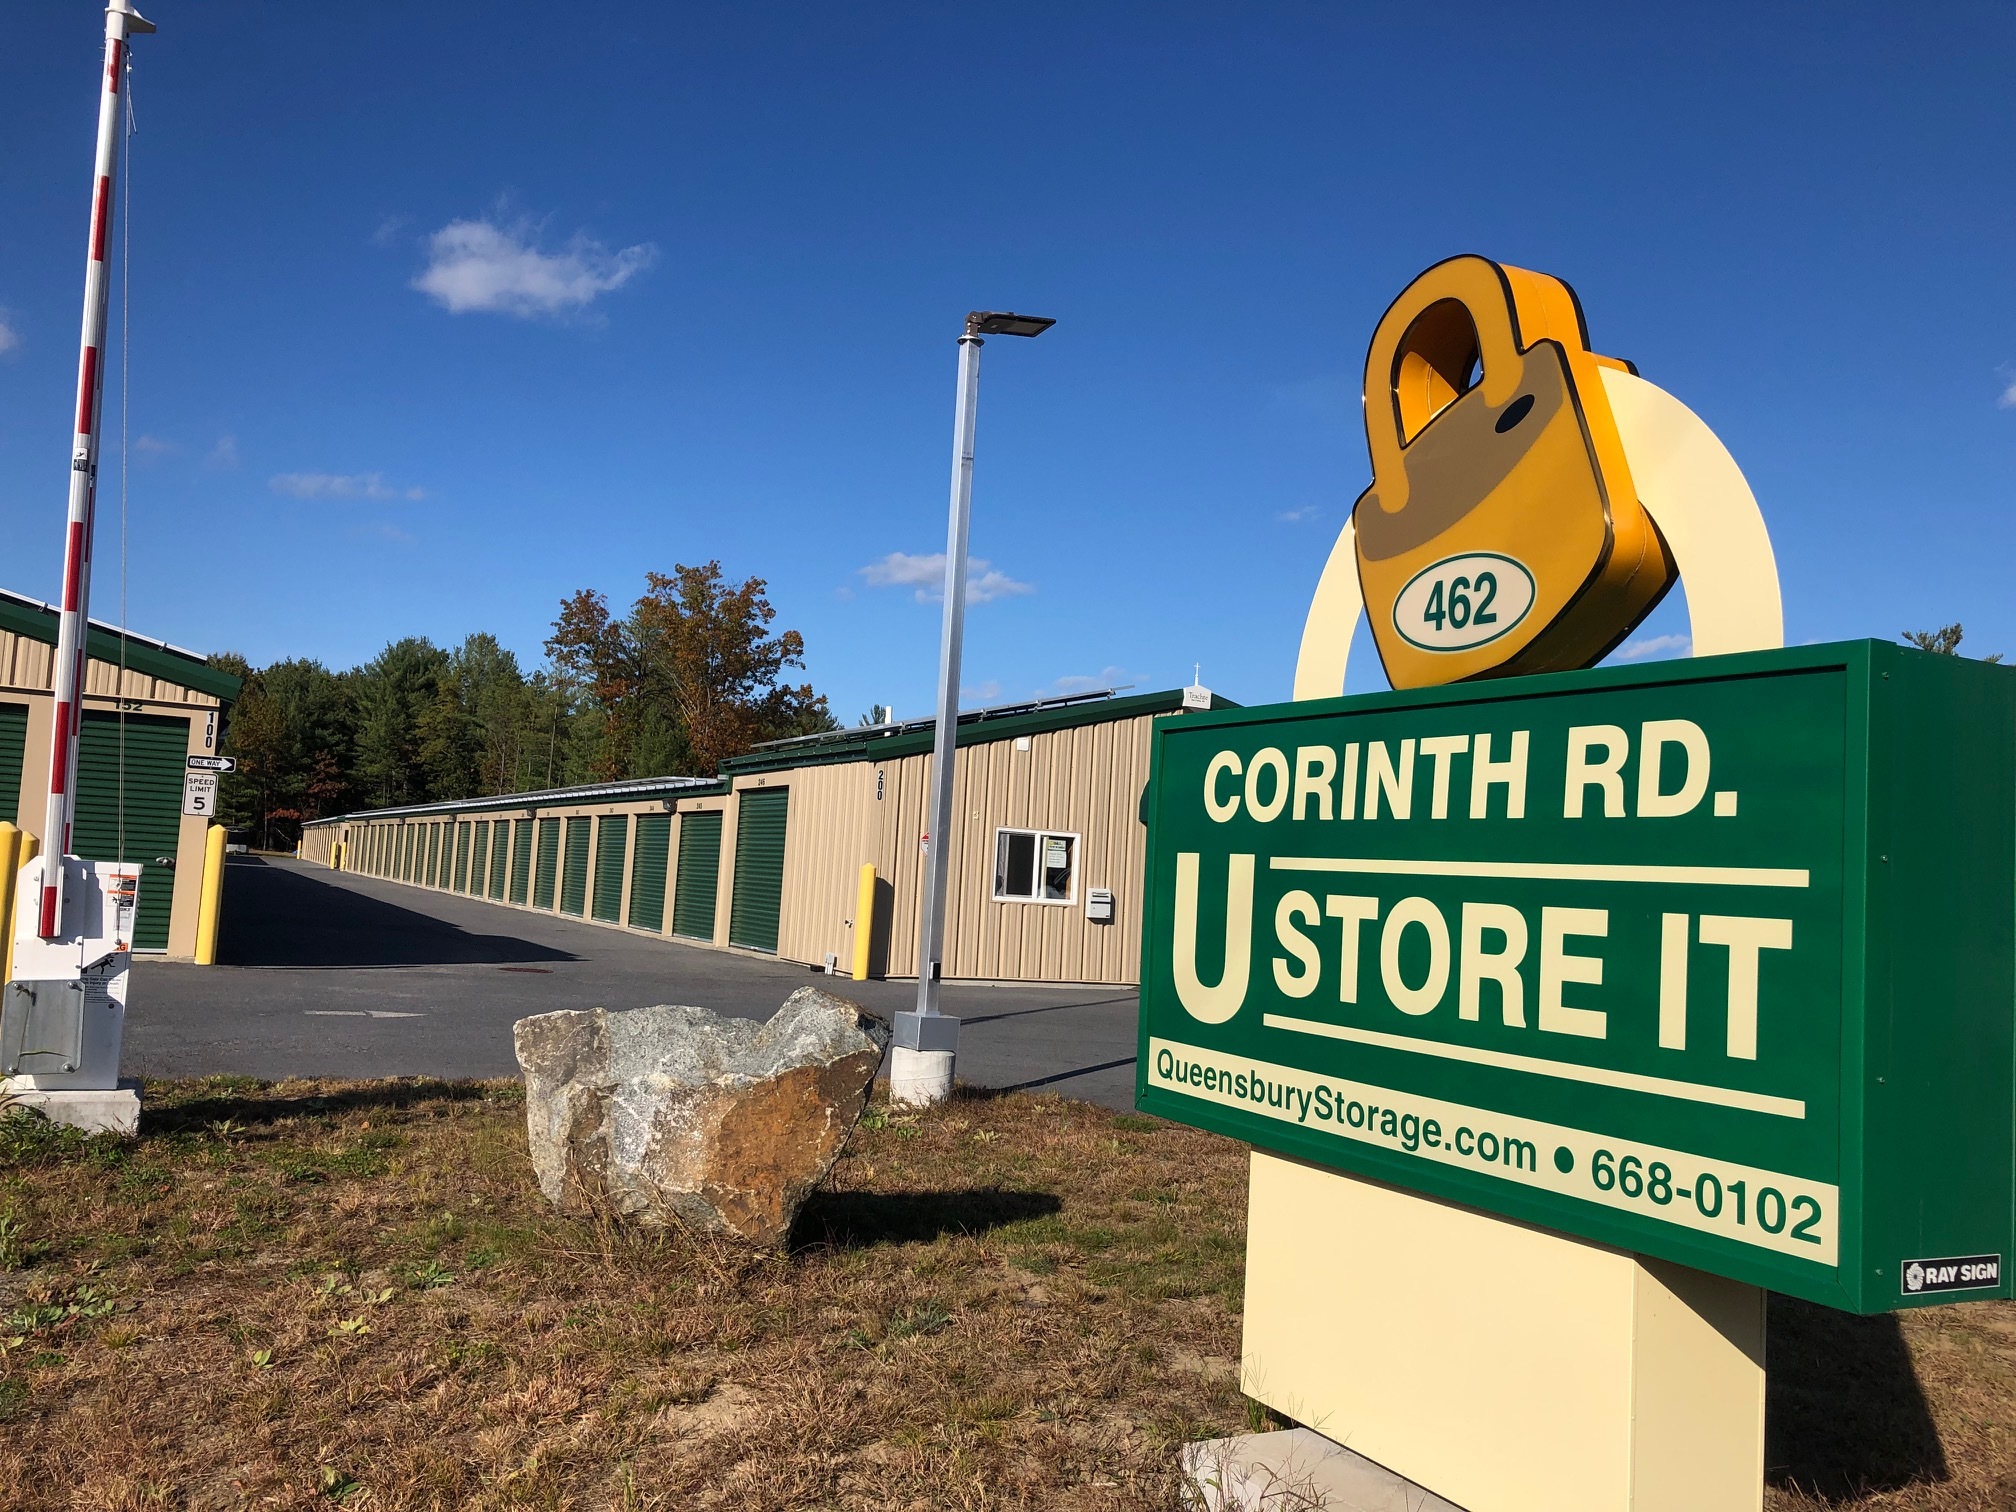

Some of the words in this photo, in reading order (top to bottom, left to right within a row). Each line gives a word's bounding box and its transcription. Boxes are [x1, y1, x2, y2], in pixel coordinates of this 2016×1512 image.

[1423, 571, 1498, 632] 462
[205, 711, 215, 748] 100
[191, 758, 205, 766] ONE
[1204, 731, 1529, 822] CORINTH
[1564, 720, 1737, 818] RD.
[188, 778, 215, 786] SPEED
[193, 797, 206, 811] 5
[1173, 853, 1255, 1024] U
[1273, 890, 1608, 1039] STORE
[1659, 913, 1792, 1060] IT
[1158, 1049, 1536, 1172] QueensburyStorage.com
[1592, 1150, 1821, 1245] 668-0102
[1925, 1266, 1959, 1284] RAY
[1960, 1262, 1998, 1281] SIGN
